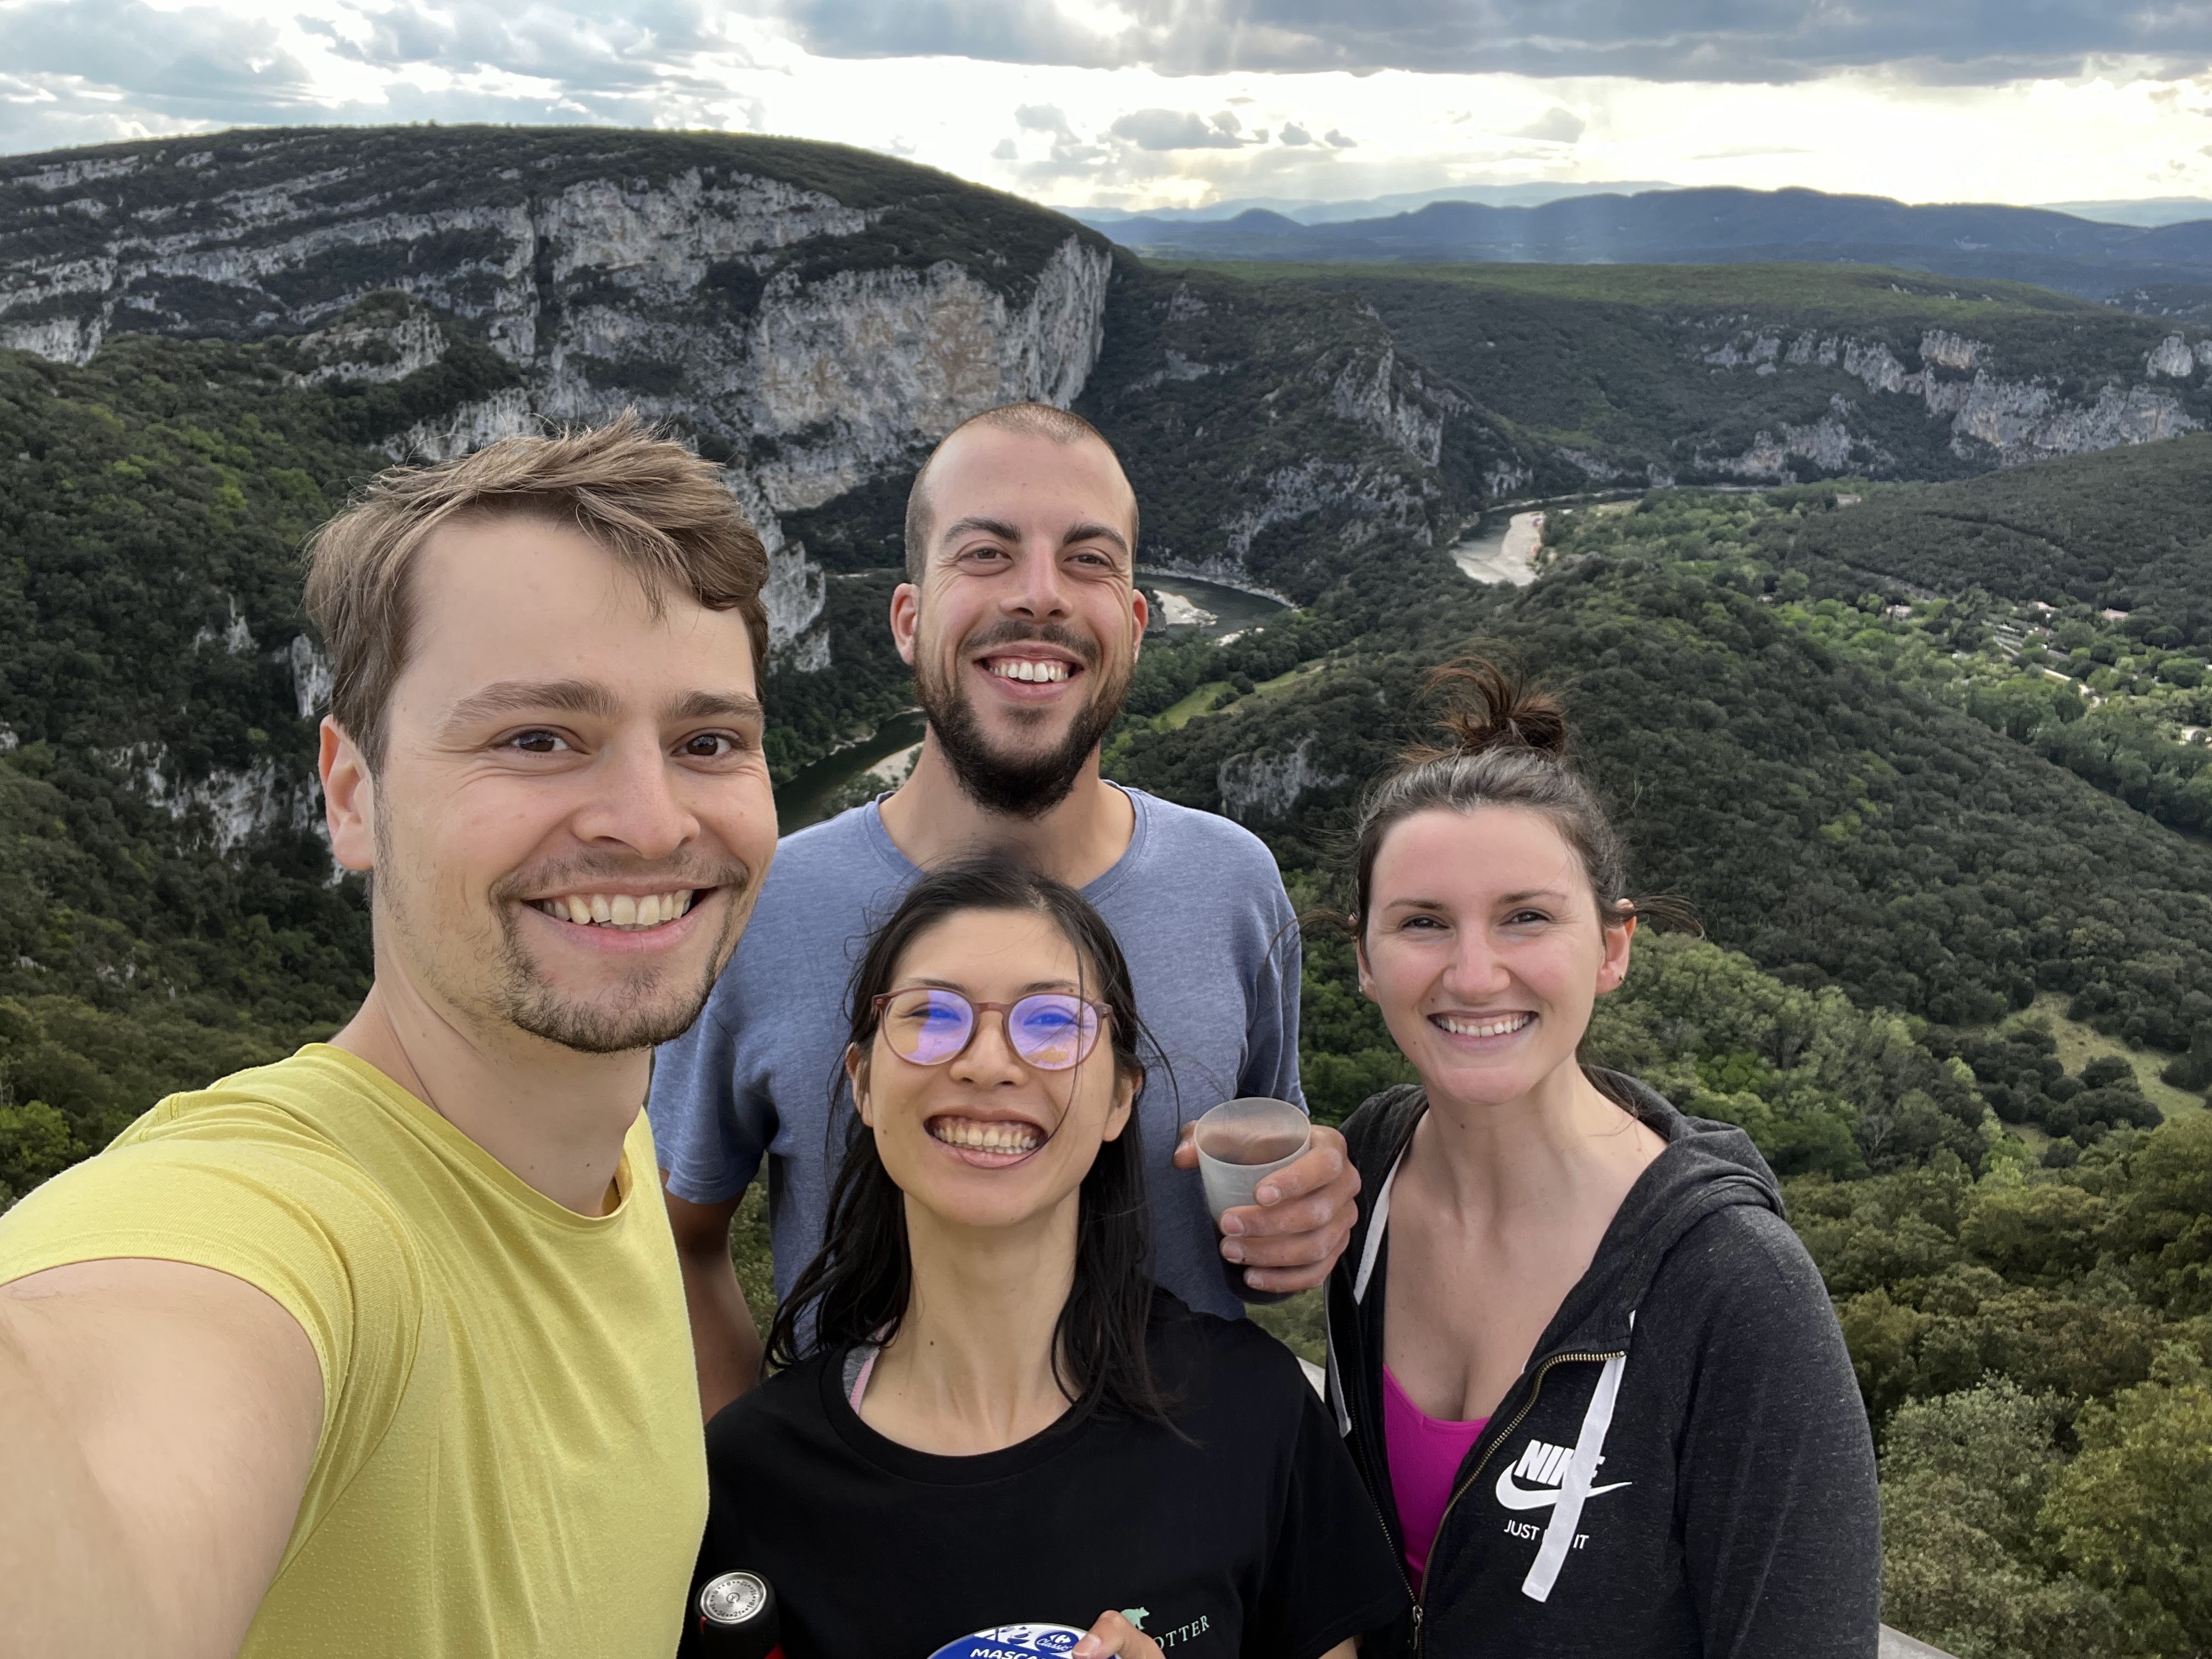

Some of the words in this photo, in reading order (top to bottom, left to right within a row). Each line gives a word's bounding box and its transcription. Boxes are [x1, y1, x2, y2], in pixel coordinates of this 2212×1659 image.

[1514, 1439, 1606, 1487] NIK
[1504, 1519, 1540, 1541] JUST
[1573, 1534, 1589, 1549] IT
